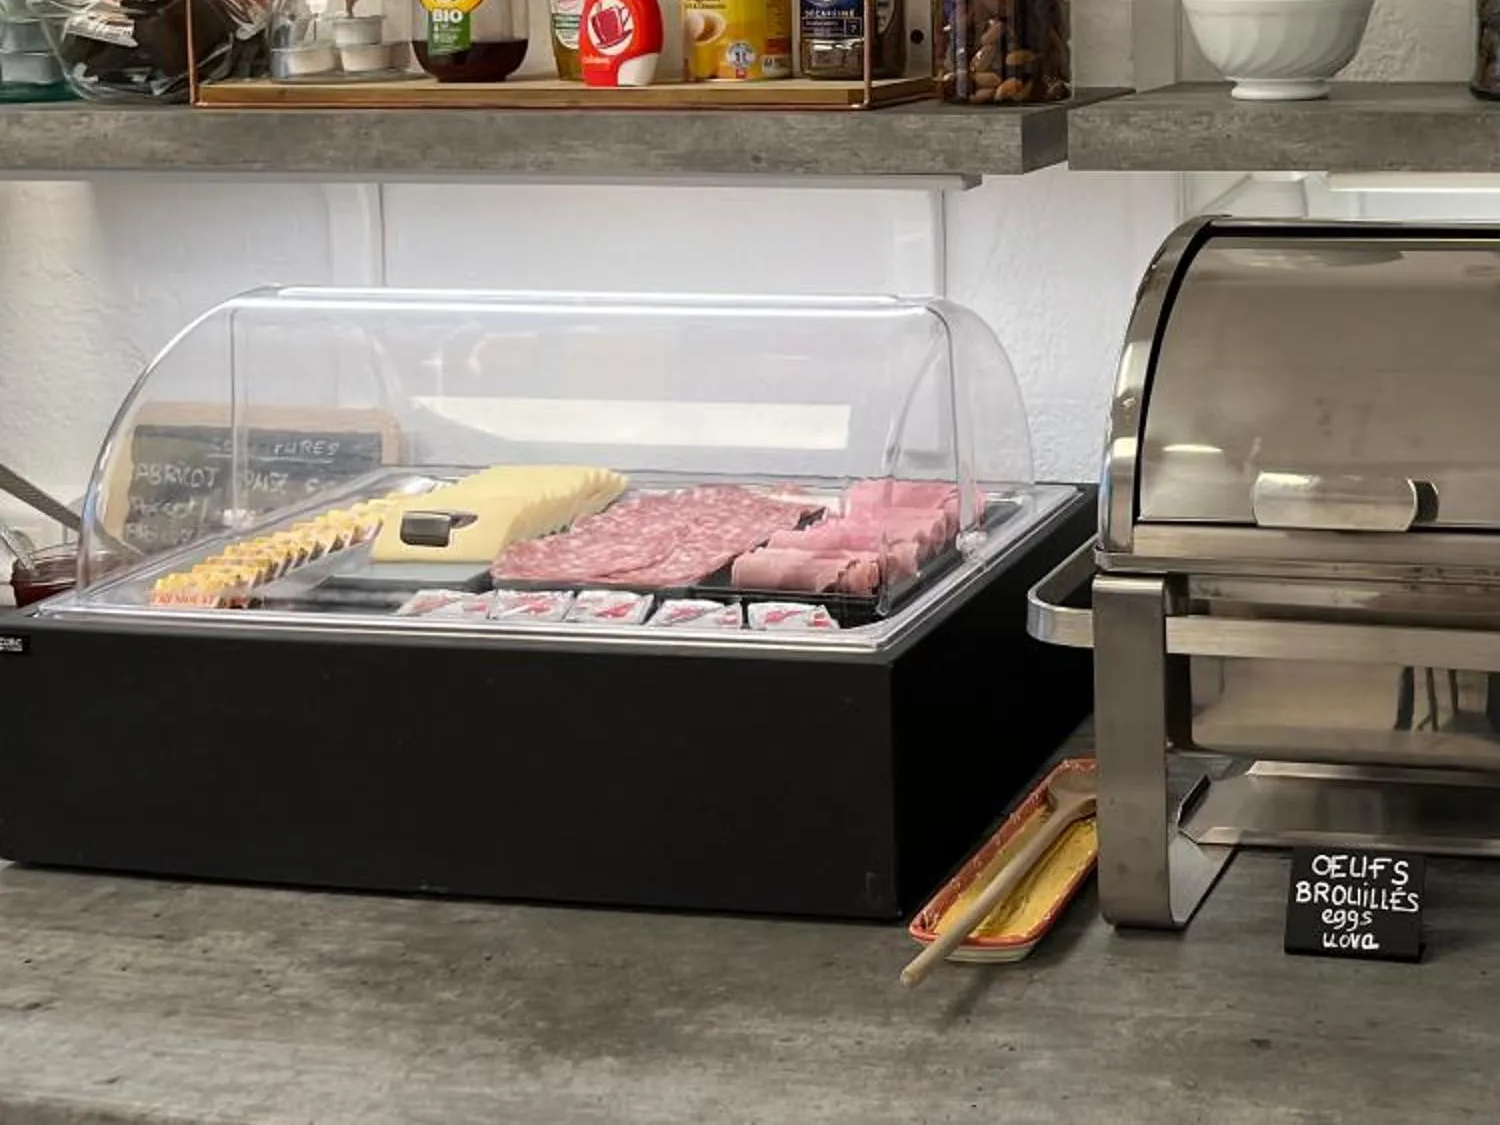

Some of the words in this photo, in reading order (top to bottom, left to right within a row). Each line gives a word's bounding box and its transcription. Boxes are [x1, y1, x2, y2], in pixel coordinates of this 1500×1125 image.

[432, 8, 463, 23] BIO
[1321, 908, 1373, 932] eggs
[1322, 932, 1380, 950] uova
